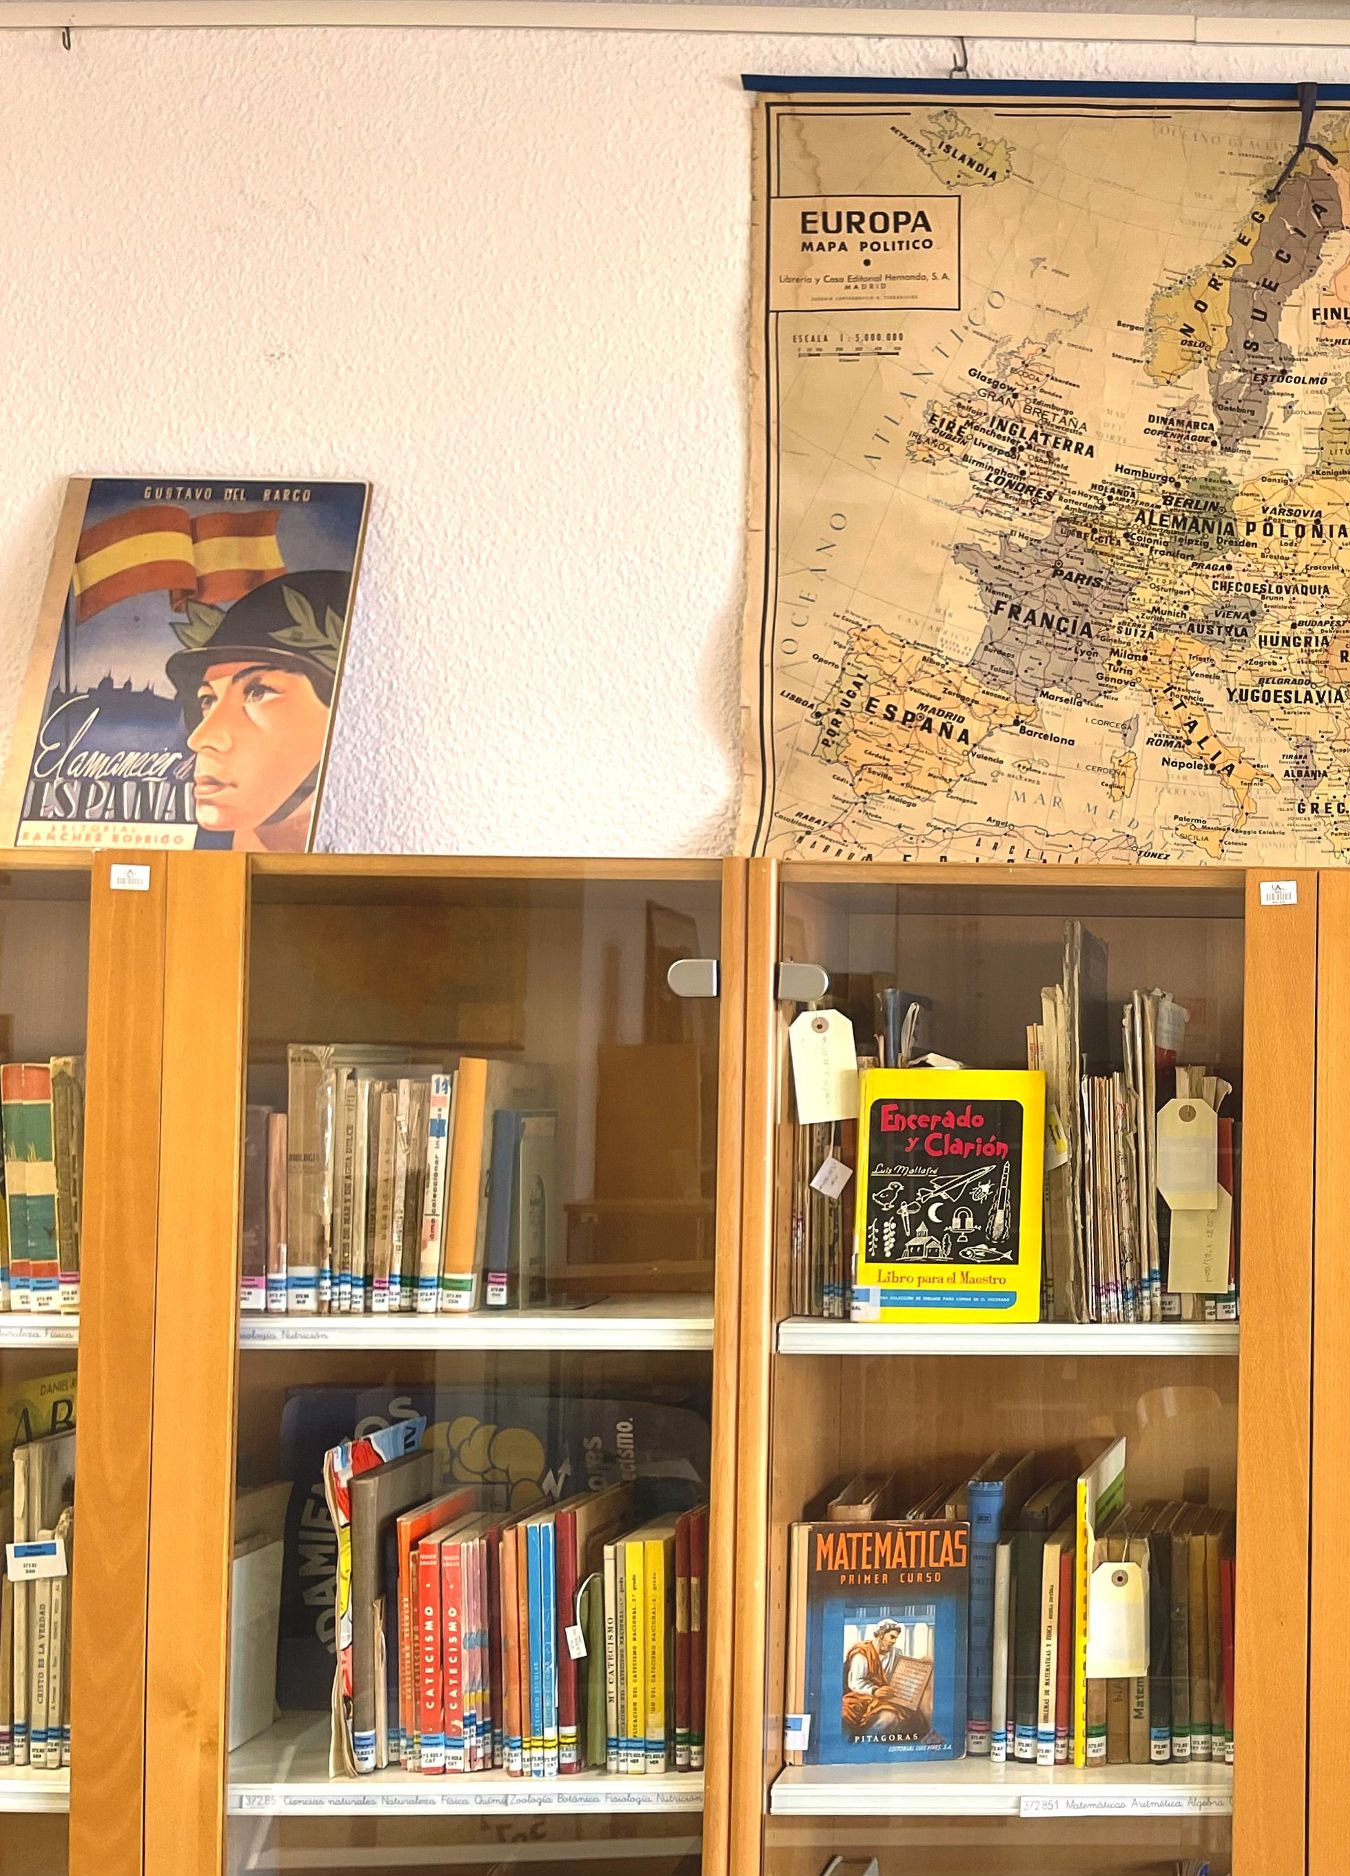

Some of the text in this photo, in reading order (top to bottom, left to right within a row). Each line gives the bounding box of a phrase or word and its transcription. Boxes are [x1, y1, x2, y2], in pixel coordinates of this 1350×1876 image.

[936, 140, 999, 182] ISLANDIA
[800, 210, 933, 235] EUROPA
[801, 238, 934, 252] MAPA POLITICO
[1180, 208, 1268, 338] NORUEG
[1243, 201, 1329, 352] SUECIA
[967, 367, 1017, 394] Glasgow
[1252, 373, 1329, 386] ESTOCOLMO
[1147, 414, 1215, 432] DINAMARCA
[988, 415, 1095, 459] INGLATERRA
[973, 437, 1021, 462] Liverpool
[1114, 463, 1176, 485] Hamburgo
[143, 486, 312, 502] GUSTAVO DEL BARCO
[984, 472, 1057, 502] LONDRES
[1162, 495, 1221, 513] BERLIN
[1261, 505, 1323, 519] VARSOVIA
[1135, 510, 1235, 538] ALEMANIA
[1245, 521, 1349, 539] POLONIA
[1051, 568, 1103, 588] PARIS
[1191, 561, 1227, 572] PRAGA
[1211, 580, 1330, 596] CHECOESLOVAQUIA
[993, 600, 1093, 639] FRANCIA
[1213, 609, 1250, 620] VIENA
[1258, 634, 1331, 648] HUNGRIA
[1257, 677, 1312, 687] BELGRADO
[1226, 687, 1344, 705] YUGOESLAVIA
[820, 672, 869, 748] PORTUGAL
[864, 696, 970, 746] ESPAÑA
[916, 701, 967, 725] MADRID
[1018, 725, 1076, 748] Barcelona
[1145, 737, 1183, 749] ROMA
[880, 1103, 985, 1132] Encerado
[904, 1133, 1009, 1159] y Clarión
[871, 1163, 893, 1175] Luis
[877, 1269, 1007, 1287] Libro para el Maestro
[815, 1528, 968, 1571] MATEMÁTICAS
[839, 1572, 942, 1585] PRIMER CURSO
[38, 1603, 46, 1639] VERDAD
[38, 1643, 46, 1655] LA
[425, 1606, 435, 1710] CATECISMO
[448, 1606, 458, 1711] CATECISMO
[607, 1616, 615, 1690] CATECISMO
[37, 1672, 46, 1704] CRISTO
[854, 1733, 919, 1743] PITAGORAS
